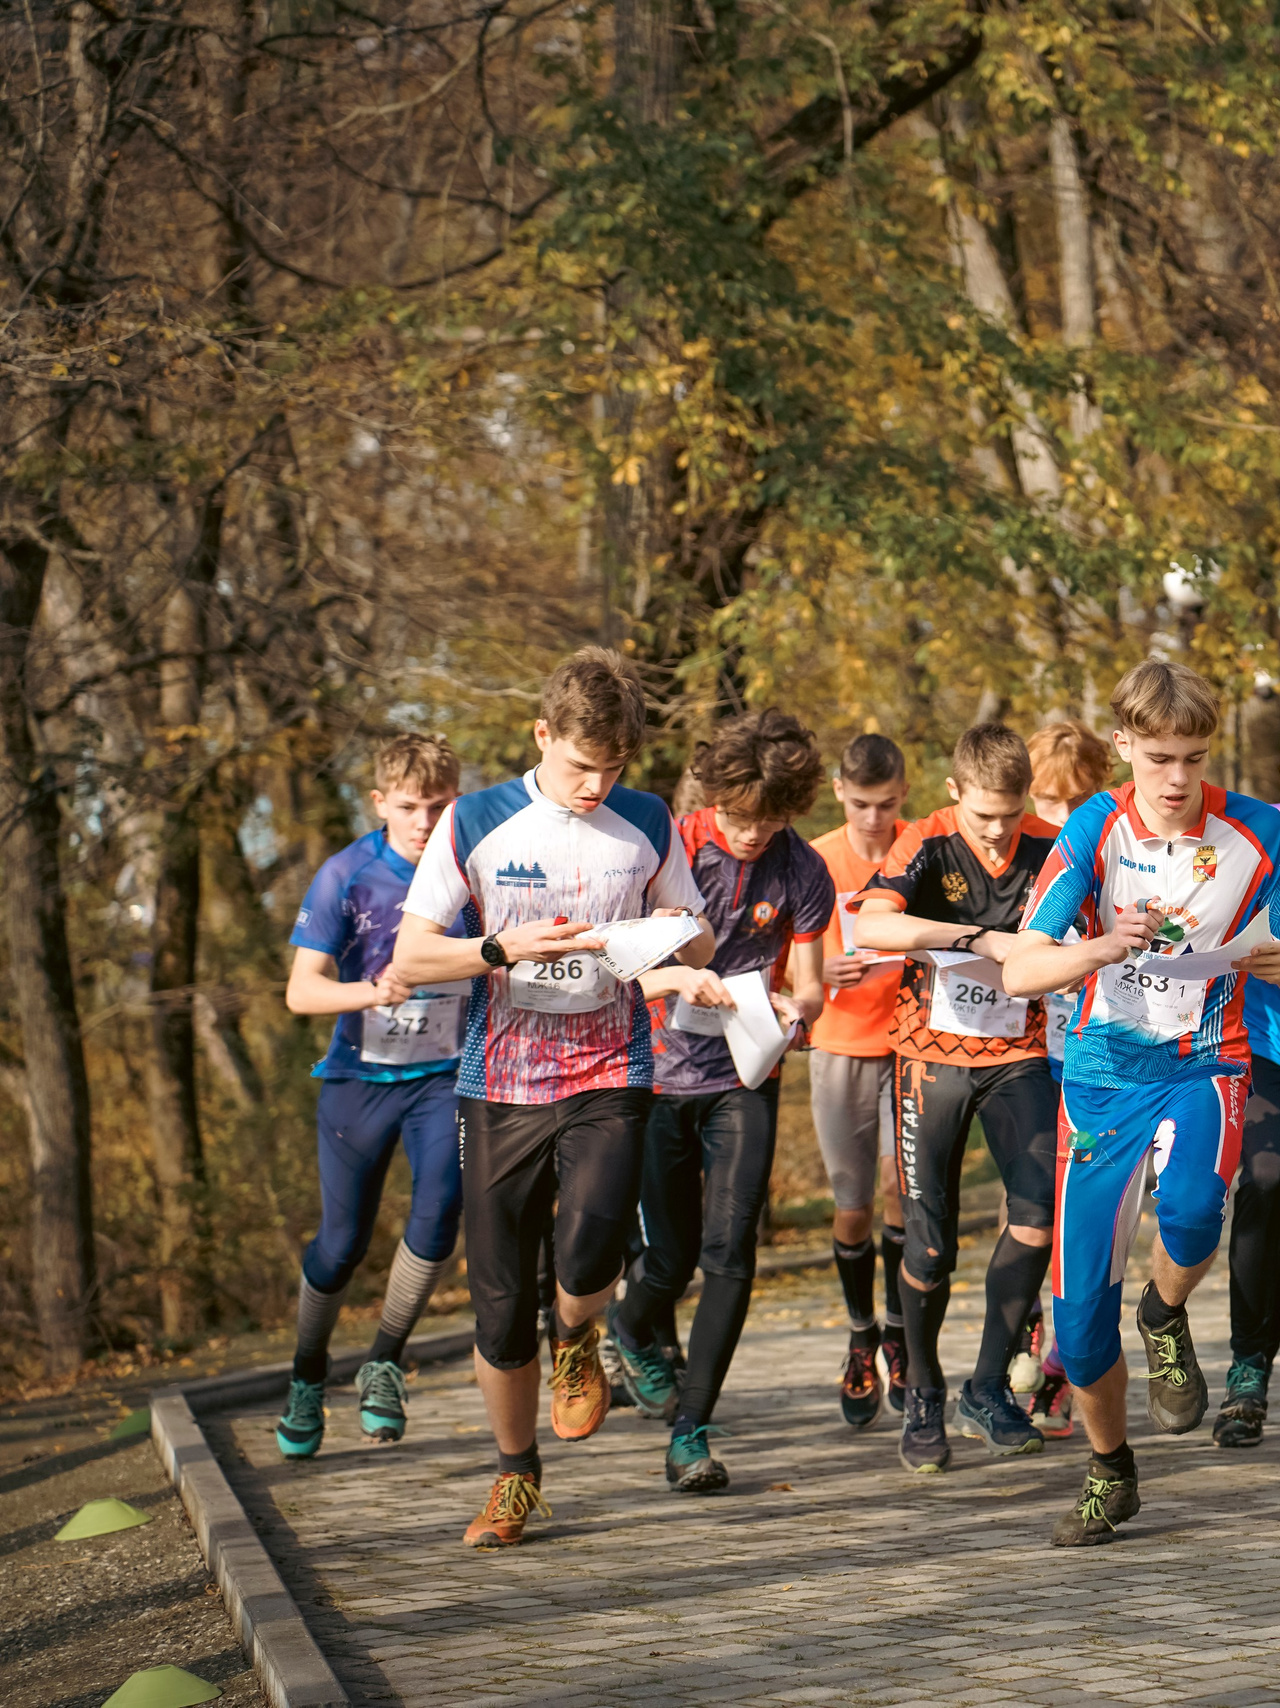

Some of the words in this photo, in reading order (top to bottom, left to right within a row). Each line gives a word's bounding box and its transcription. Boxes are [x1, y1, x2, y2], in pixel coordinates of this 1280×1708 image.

[533, 959, 583, 980] 266
[1120, 963, 1170, 993] 263
[955, 983, 998, 1006] 264
[1114, 979, 1145, 997] МЖ16
[1179, 985, 1186, 998] 1
[386, 1016, 430, 1036] 272
